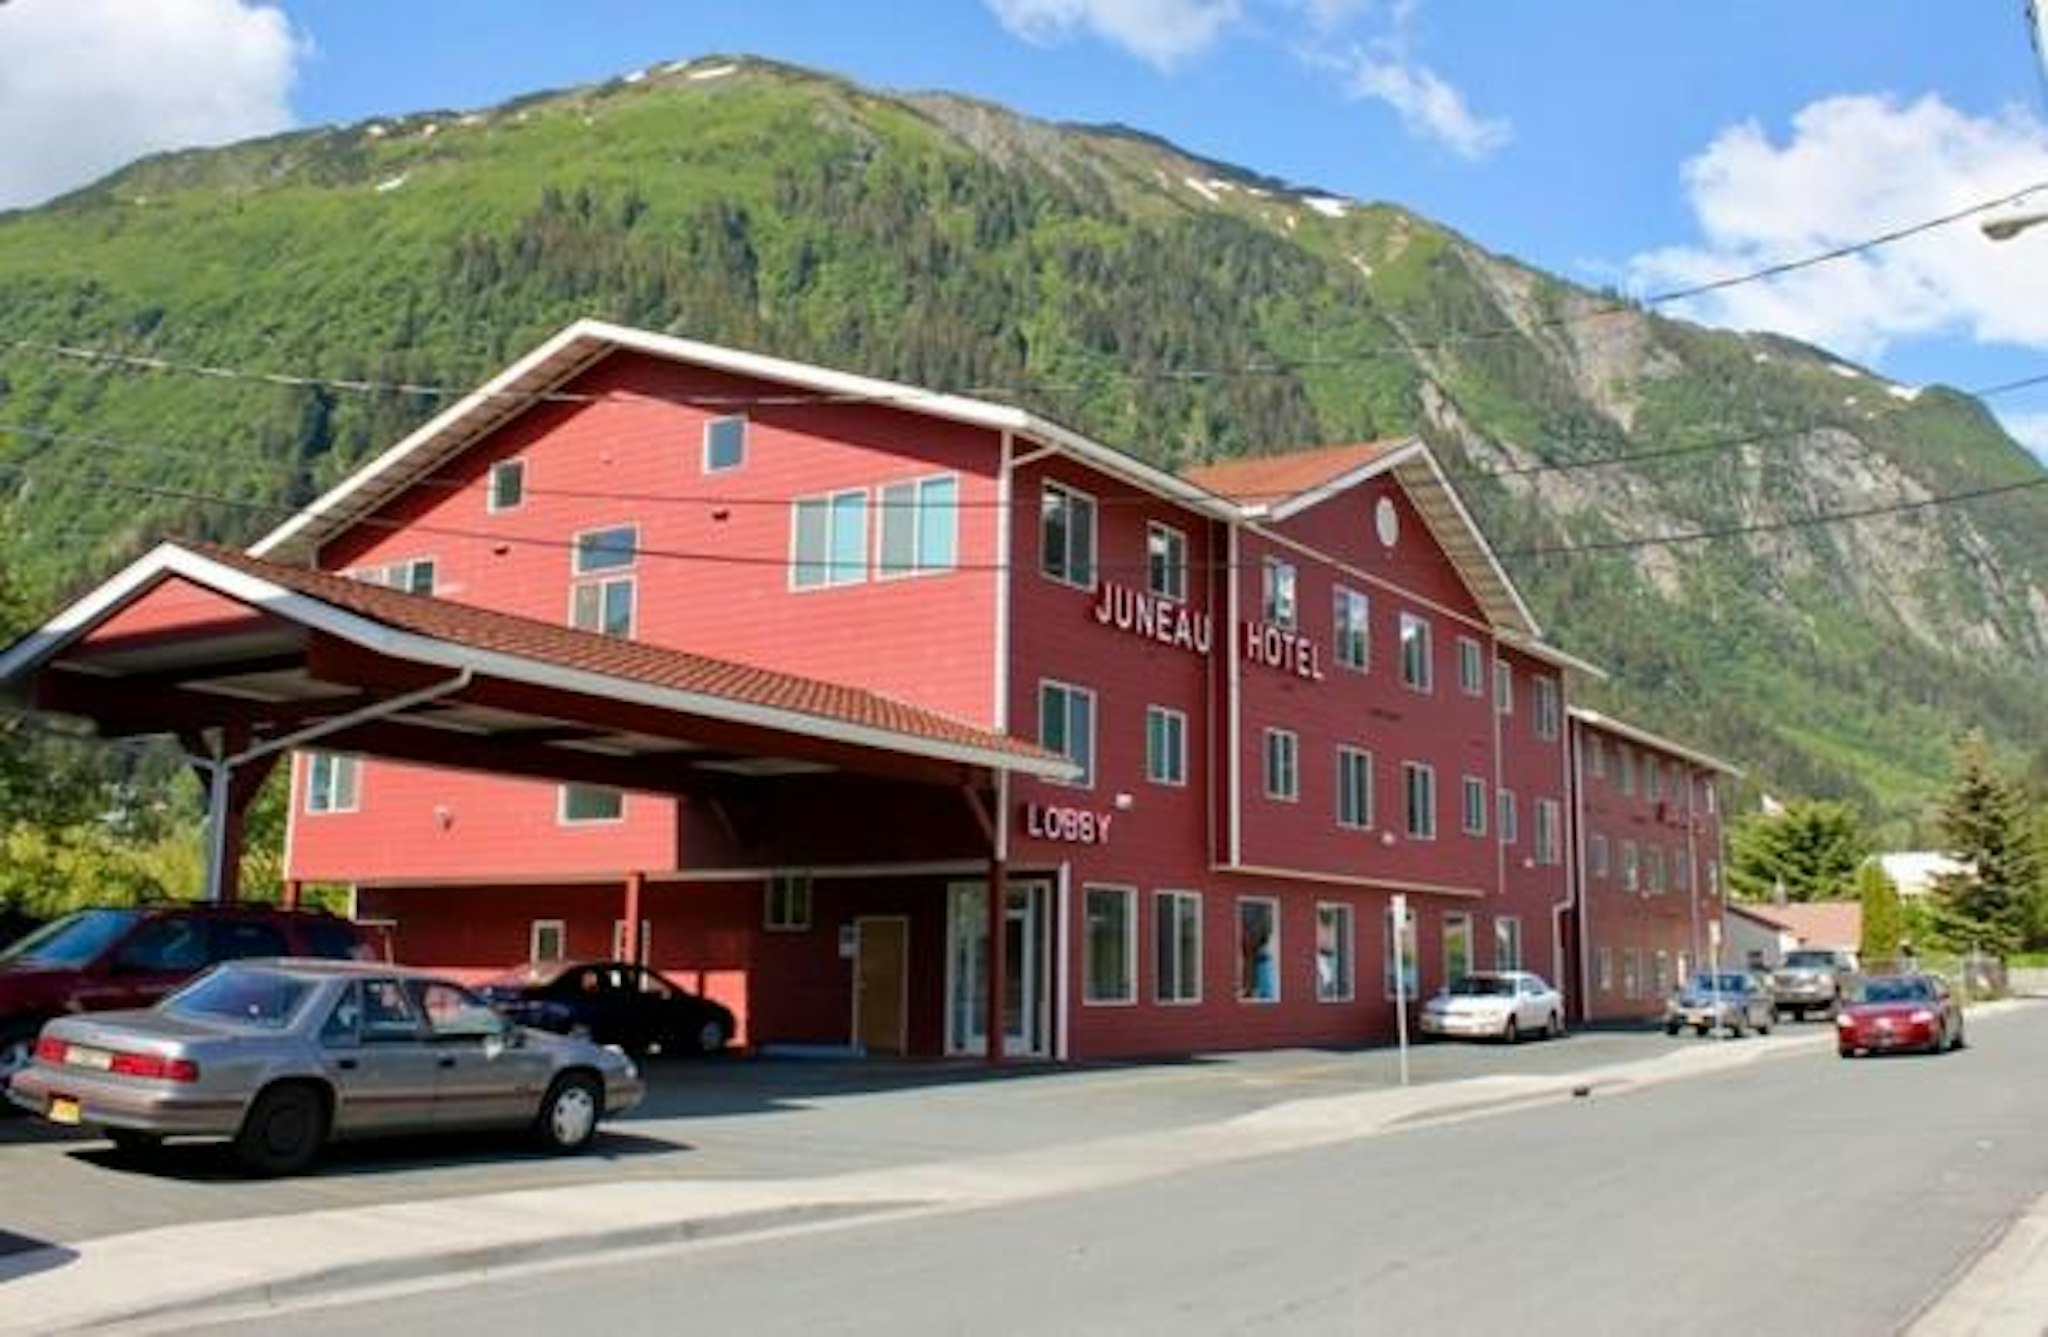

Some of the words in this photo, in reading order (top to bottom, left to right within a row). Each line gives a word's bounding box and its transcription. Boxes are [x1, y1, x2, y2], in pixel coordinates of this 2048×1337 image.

[1096, 582, 1212, 652] JUNEAU
[1248, 622, 1325, 679] HOTEL
[1027, 803, 1112, 844] LOBBY
